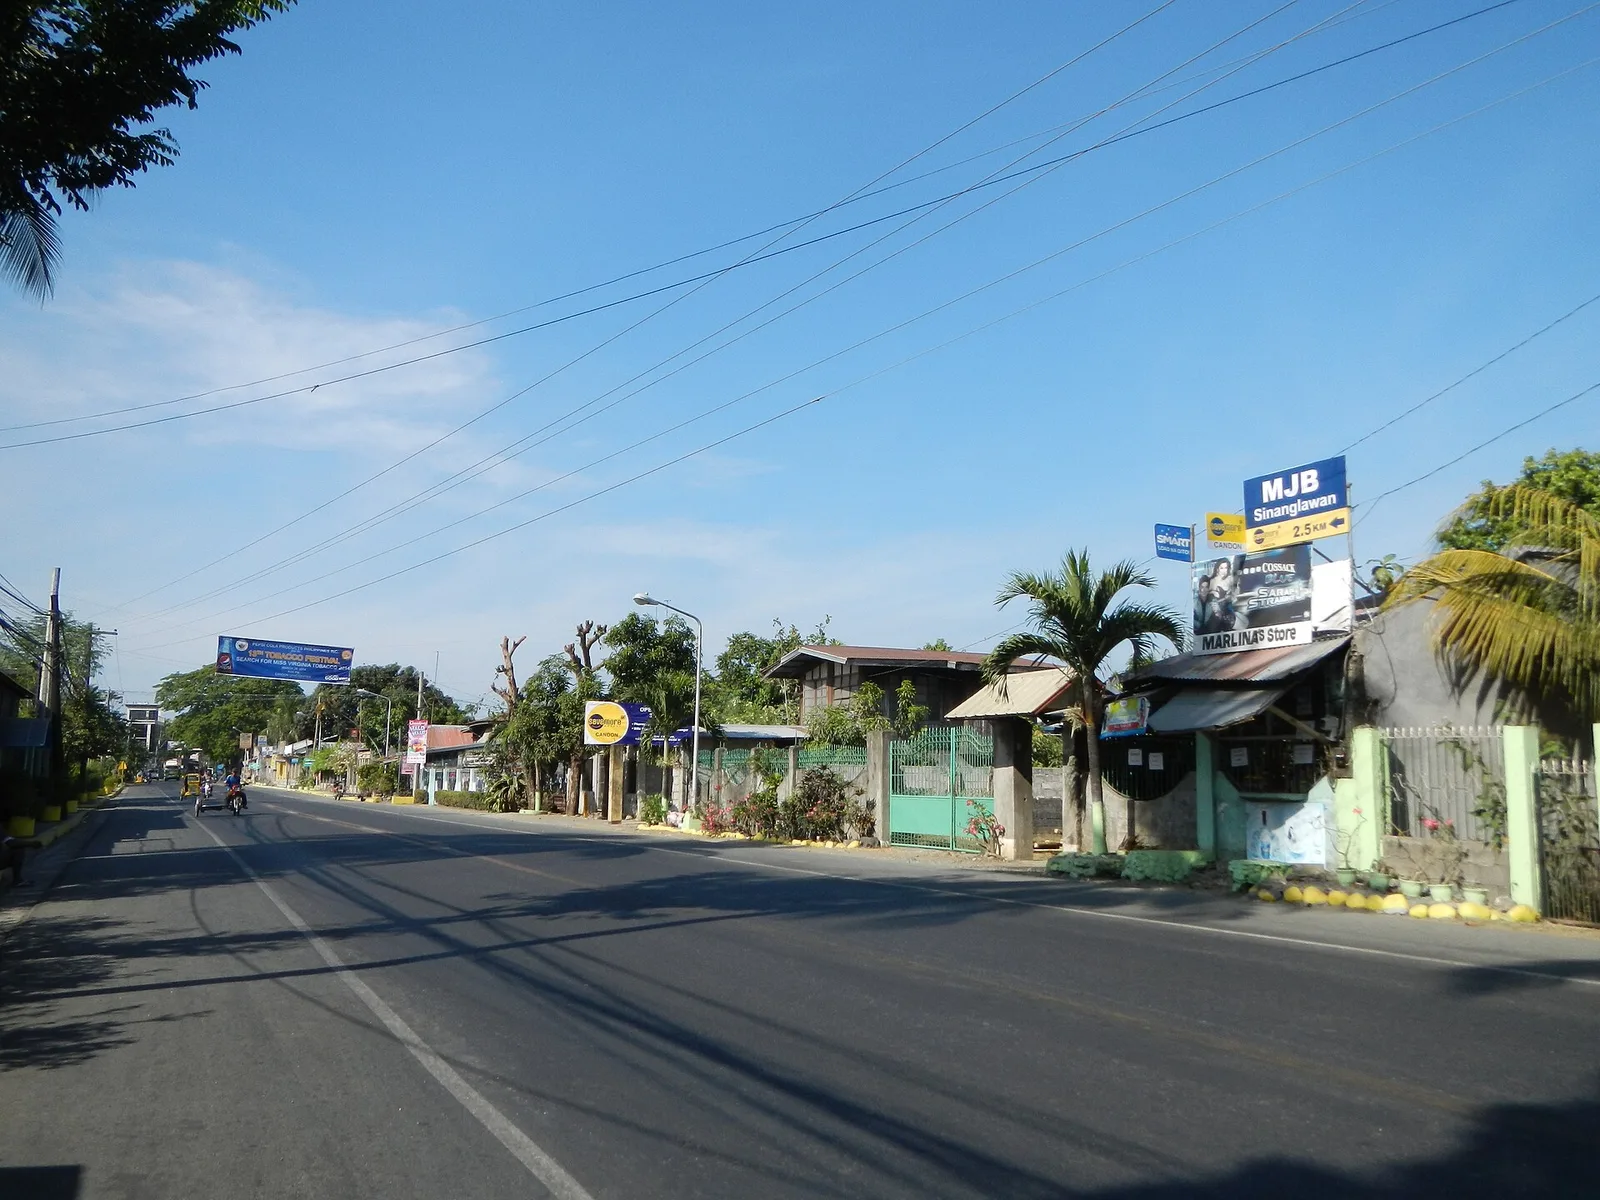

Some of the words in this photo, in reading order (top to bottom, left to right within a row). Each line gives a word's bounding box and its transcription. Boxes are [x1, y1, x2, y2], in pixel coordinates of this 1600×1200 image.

[1262, 469, 1319, 503] MJB
[1253, 494, 1337, 521] Sinanglawan
[1293, 523, 1311, 537] 2.5
[1313, 522, 1327, 532] KM
[1156, 534, 1191, 547] SMART
[1213, 541, 1242, 550] CANDON
[1262, 563, 1296, 573] COSSACK
[1202, 629, 1265, 651] MARLINA'S
[1267, 627, 1297, 642] Store
[236, 656, 259, 664] SEARCH
[265, 651, 304, 662] TOBACCO
[305, 654, 340, 665] FESTIVAL
